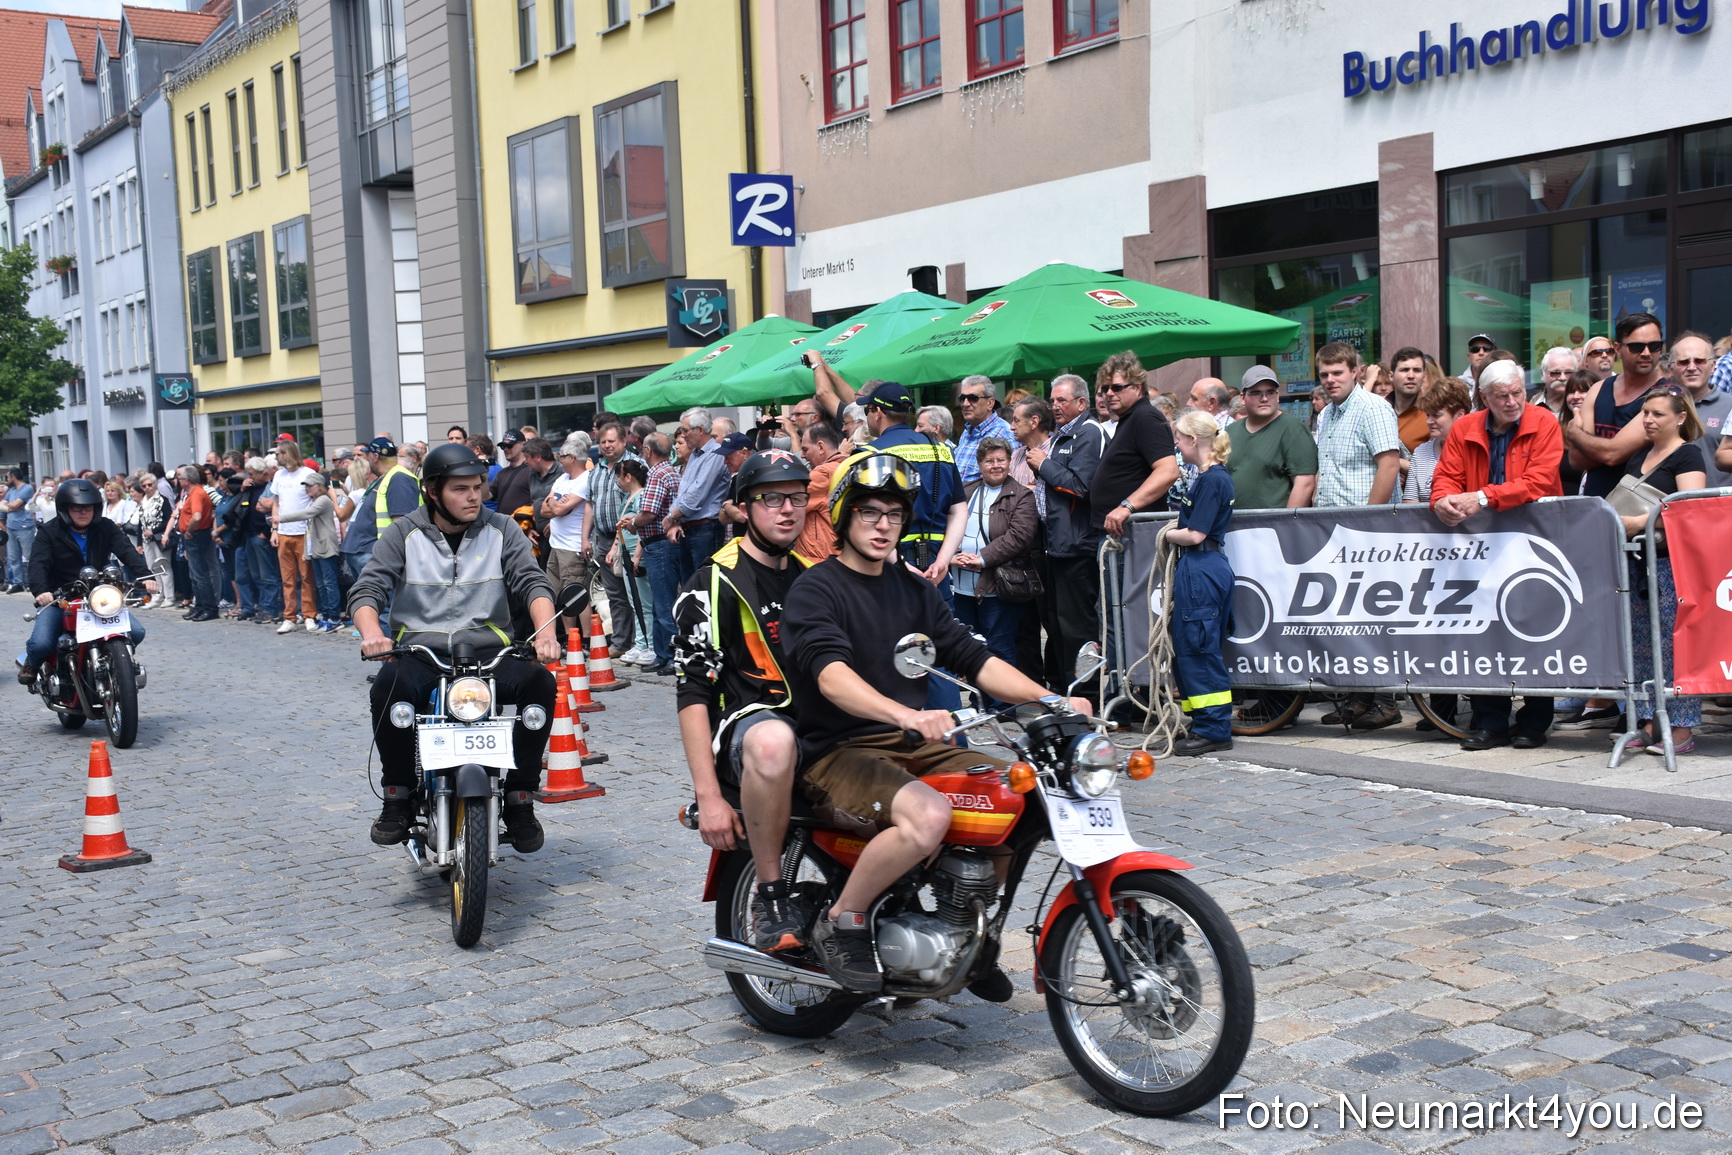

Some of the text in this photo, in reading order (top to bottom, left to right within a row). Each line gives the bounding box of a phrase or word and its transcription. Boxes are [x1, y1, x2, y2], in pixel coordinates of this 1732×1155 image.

[1344, 0, 1709, 98] Buchhandlung
[802, 258, 855, 280] Unterer Markt 15
[692, 297, 714, 326] G2
[1094, 310, 1181, 322] Neumarkter
[1088, 317, 1212, 332] Lammsbräu
[1332, 327, 1366, 338] GARTEN
[1328, 540, 1490, 564] Autoklassik
[1288, 568, 1480, 617] Dietz
[101, 616, 121, 625] 536
[1280, 624, 1384, 636] BREITENBRUNN
[1228, 650, 1588, 676] .autoklassik-dietz.de
[464, 734, 497, 750] 538
[939, 792, 994, 810] NDA
[1087, 807, 1114, 828] 539
